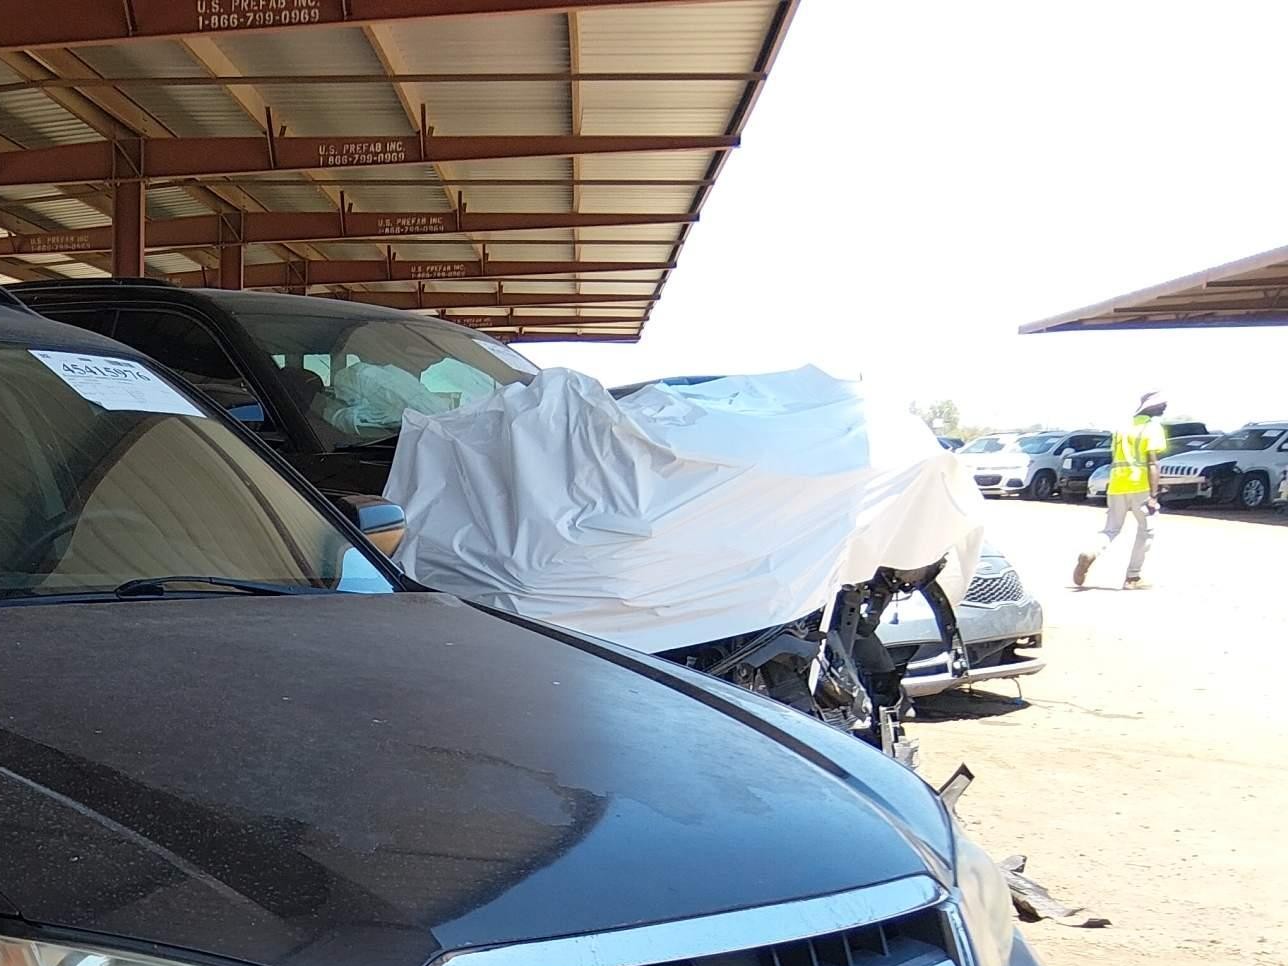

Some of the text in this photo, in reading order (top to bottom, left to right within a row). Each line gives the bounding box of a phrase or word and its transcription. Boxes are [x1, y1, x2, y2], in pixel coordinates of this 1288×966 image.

[197, 0, 223, 13] U.S.
[231, 0, 287, 11] PREFAB
[198, 9, 320, 30] 1-866-799-0969
[319, 143, 339, 156] U.S.
[343, 142, 383, 154] PREFAB
[62, 362, 151, 382] 45415976
